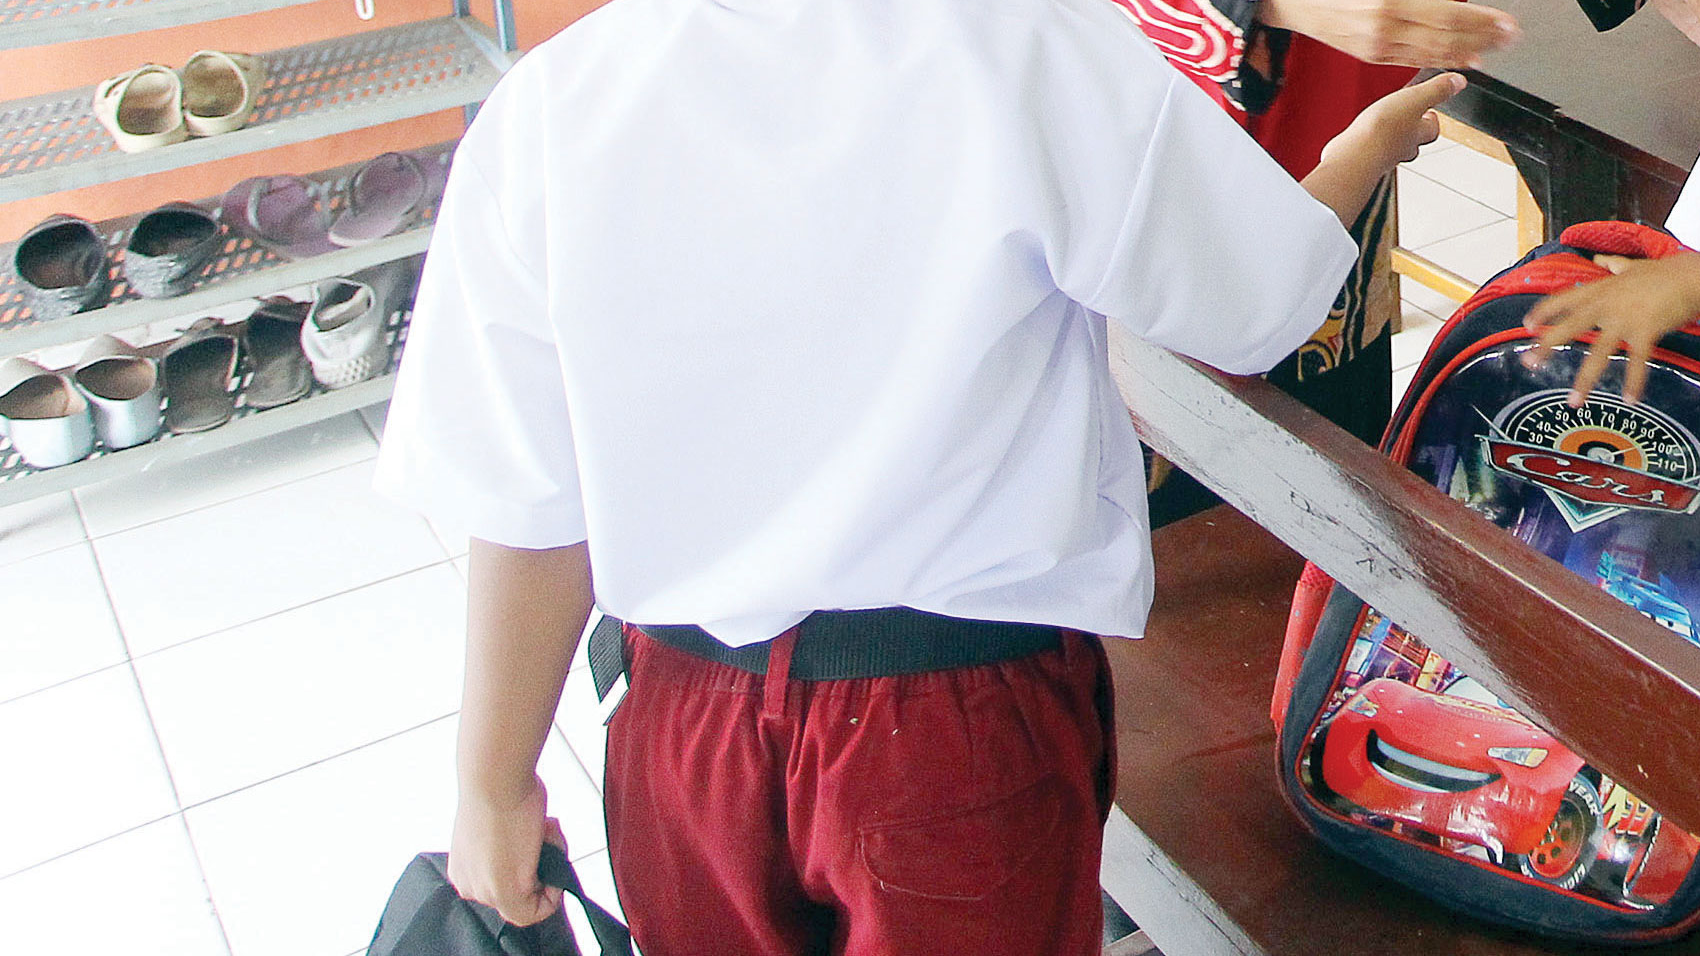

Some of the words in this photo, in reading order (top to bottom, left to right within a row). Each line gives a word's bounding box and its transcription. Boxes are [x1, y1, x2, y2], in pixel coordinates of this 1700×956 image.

[1555, 410, 1570, 422] 50
[1576, 407, 1592, 419] 60
[1601, 410, 1616, 423] 70
[1536, 421, 1551, 433] 40
[1623, 418, 1637, 431] 80
[1528, 432, 1543, 445] 30
[1640, 427, 1655, 440] 90
[1652, 441, 1673, 456] 100
[1657, 457, 1677, 472] 110
[1506, 453, 1668, 507] Cars
